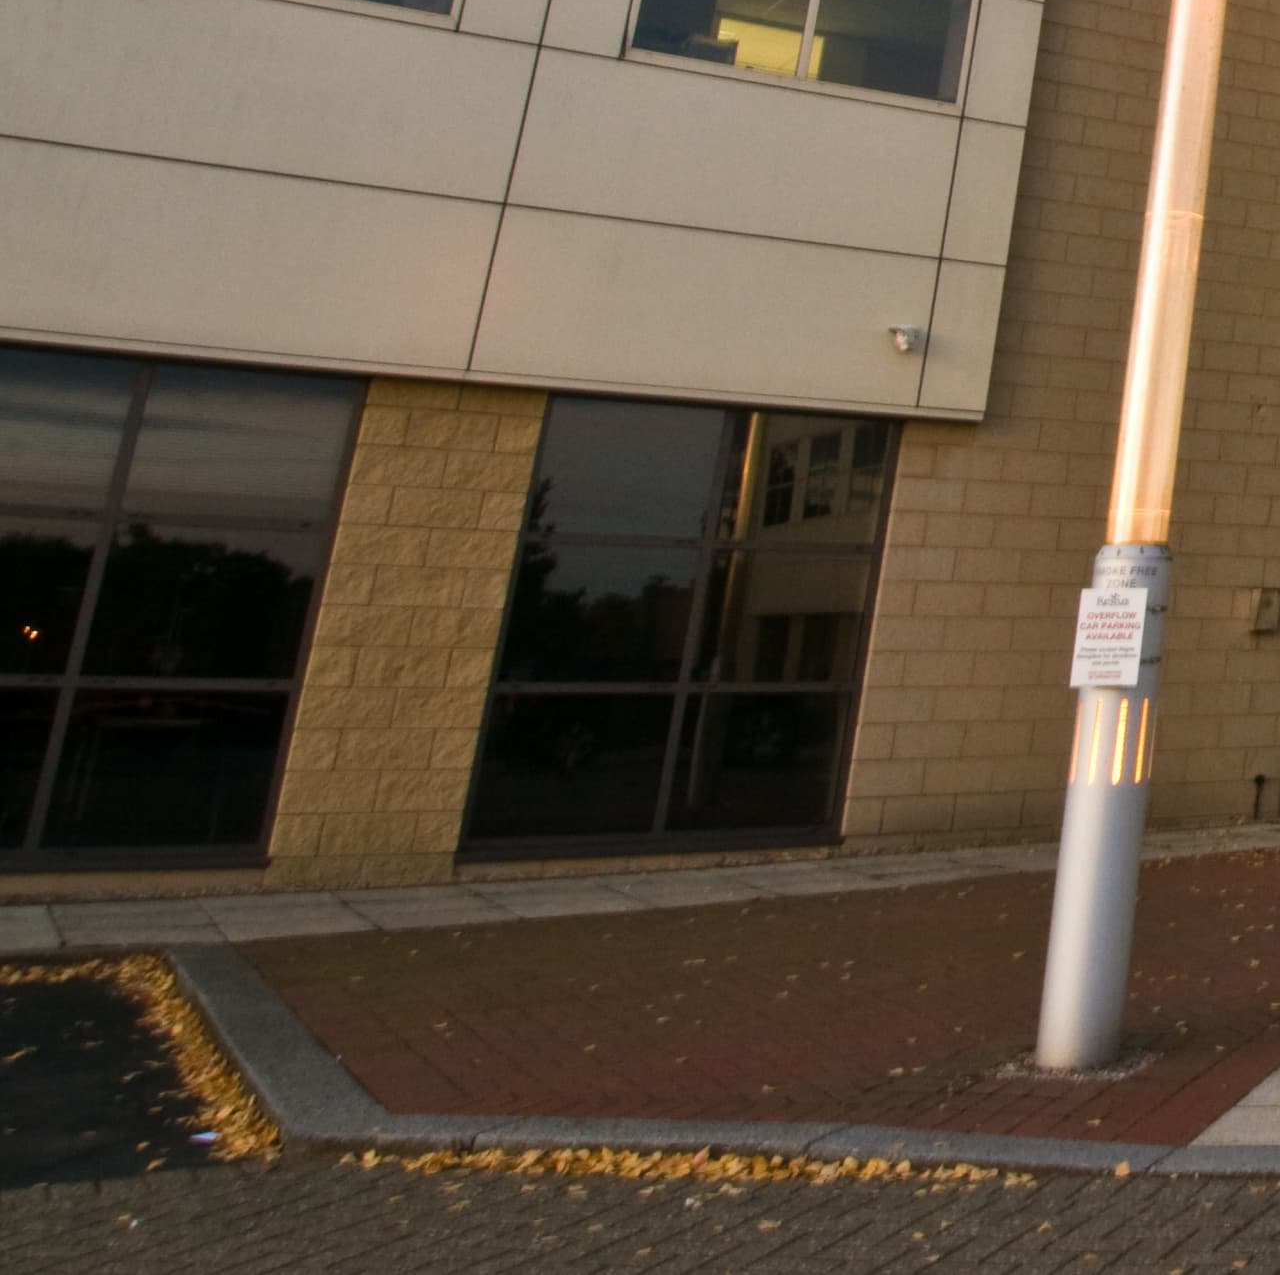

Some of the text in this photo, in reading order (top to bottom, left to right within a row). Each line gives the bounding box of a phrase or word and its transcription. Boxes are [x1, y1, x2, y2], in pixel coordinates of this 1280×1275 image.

[1130, 566, 1158, 576] FREE
[1106, 579, 1137, 588] ZONE
[1087, 612, 1137, 620] OVERFLOW
[1080, 622, 1141, 630] CAR PARKING
[1086, 632, 1133, 640] AVAILABLE
